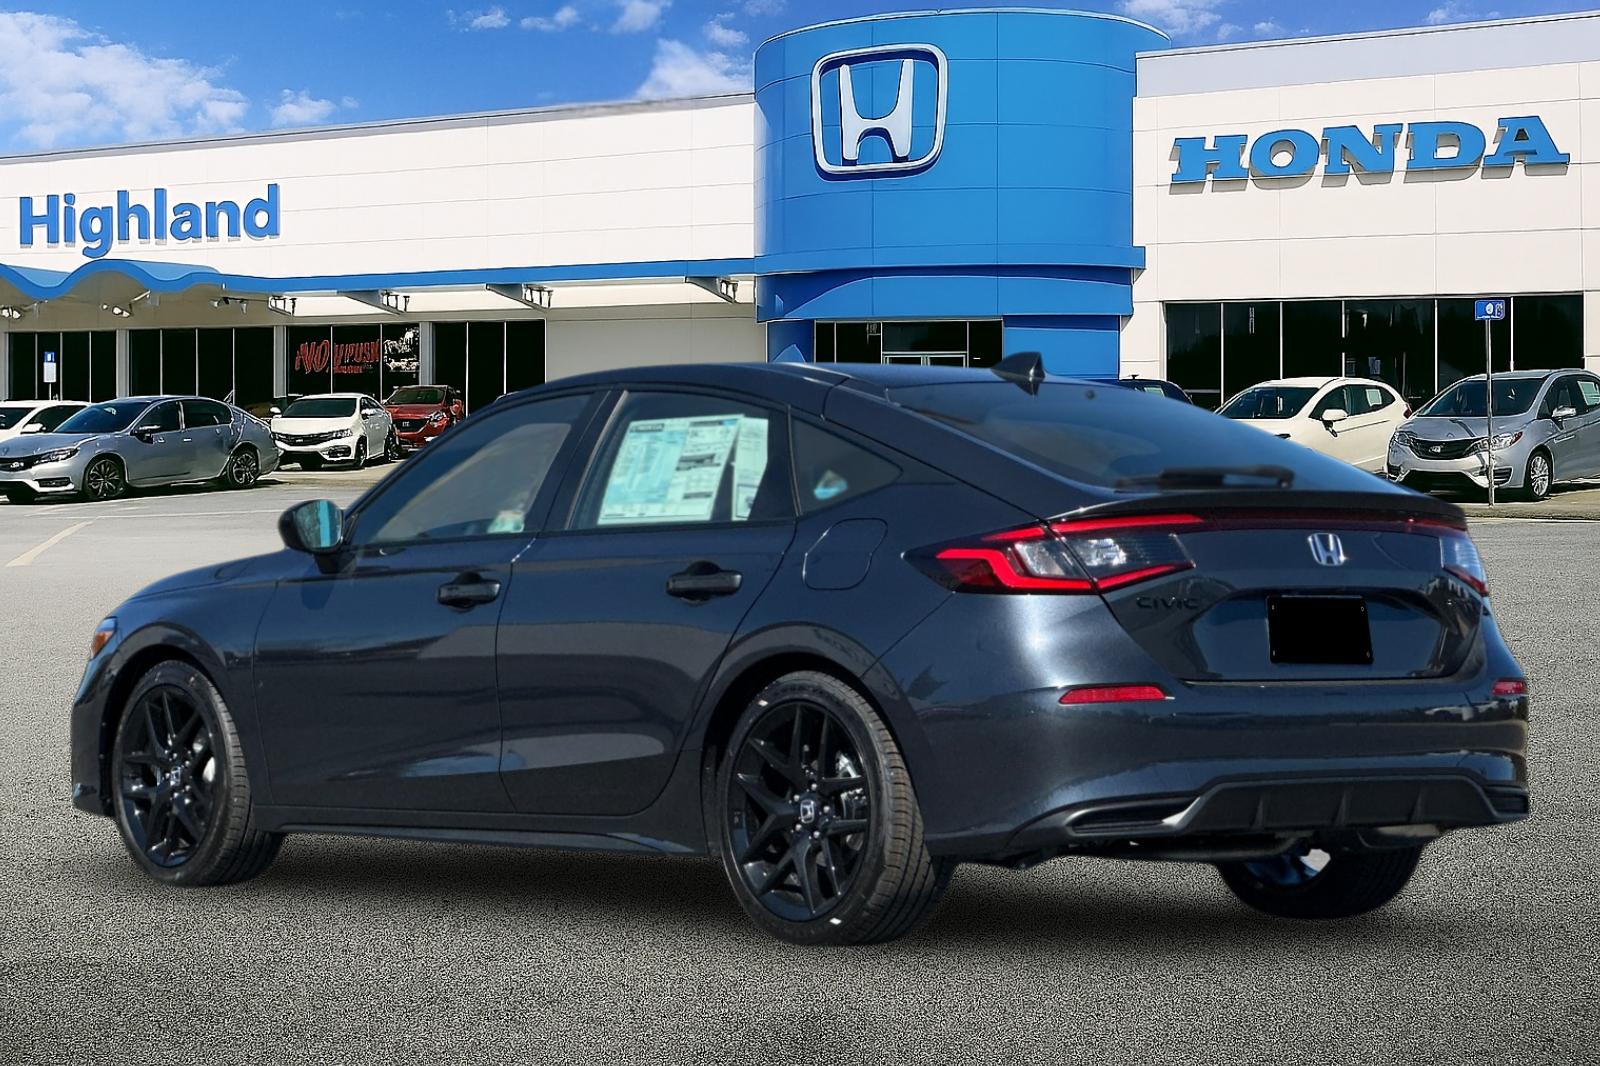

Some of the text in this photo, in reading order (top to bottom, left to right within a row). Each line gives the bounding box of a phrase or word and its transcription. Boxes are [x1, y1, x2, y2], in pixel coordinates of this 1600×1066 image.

[1171, 115, 1570, 187] HONDA
[20, 183, 281, 257] Highland
[1136, 597, 1198, 610] CIVIC
